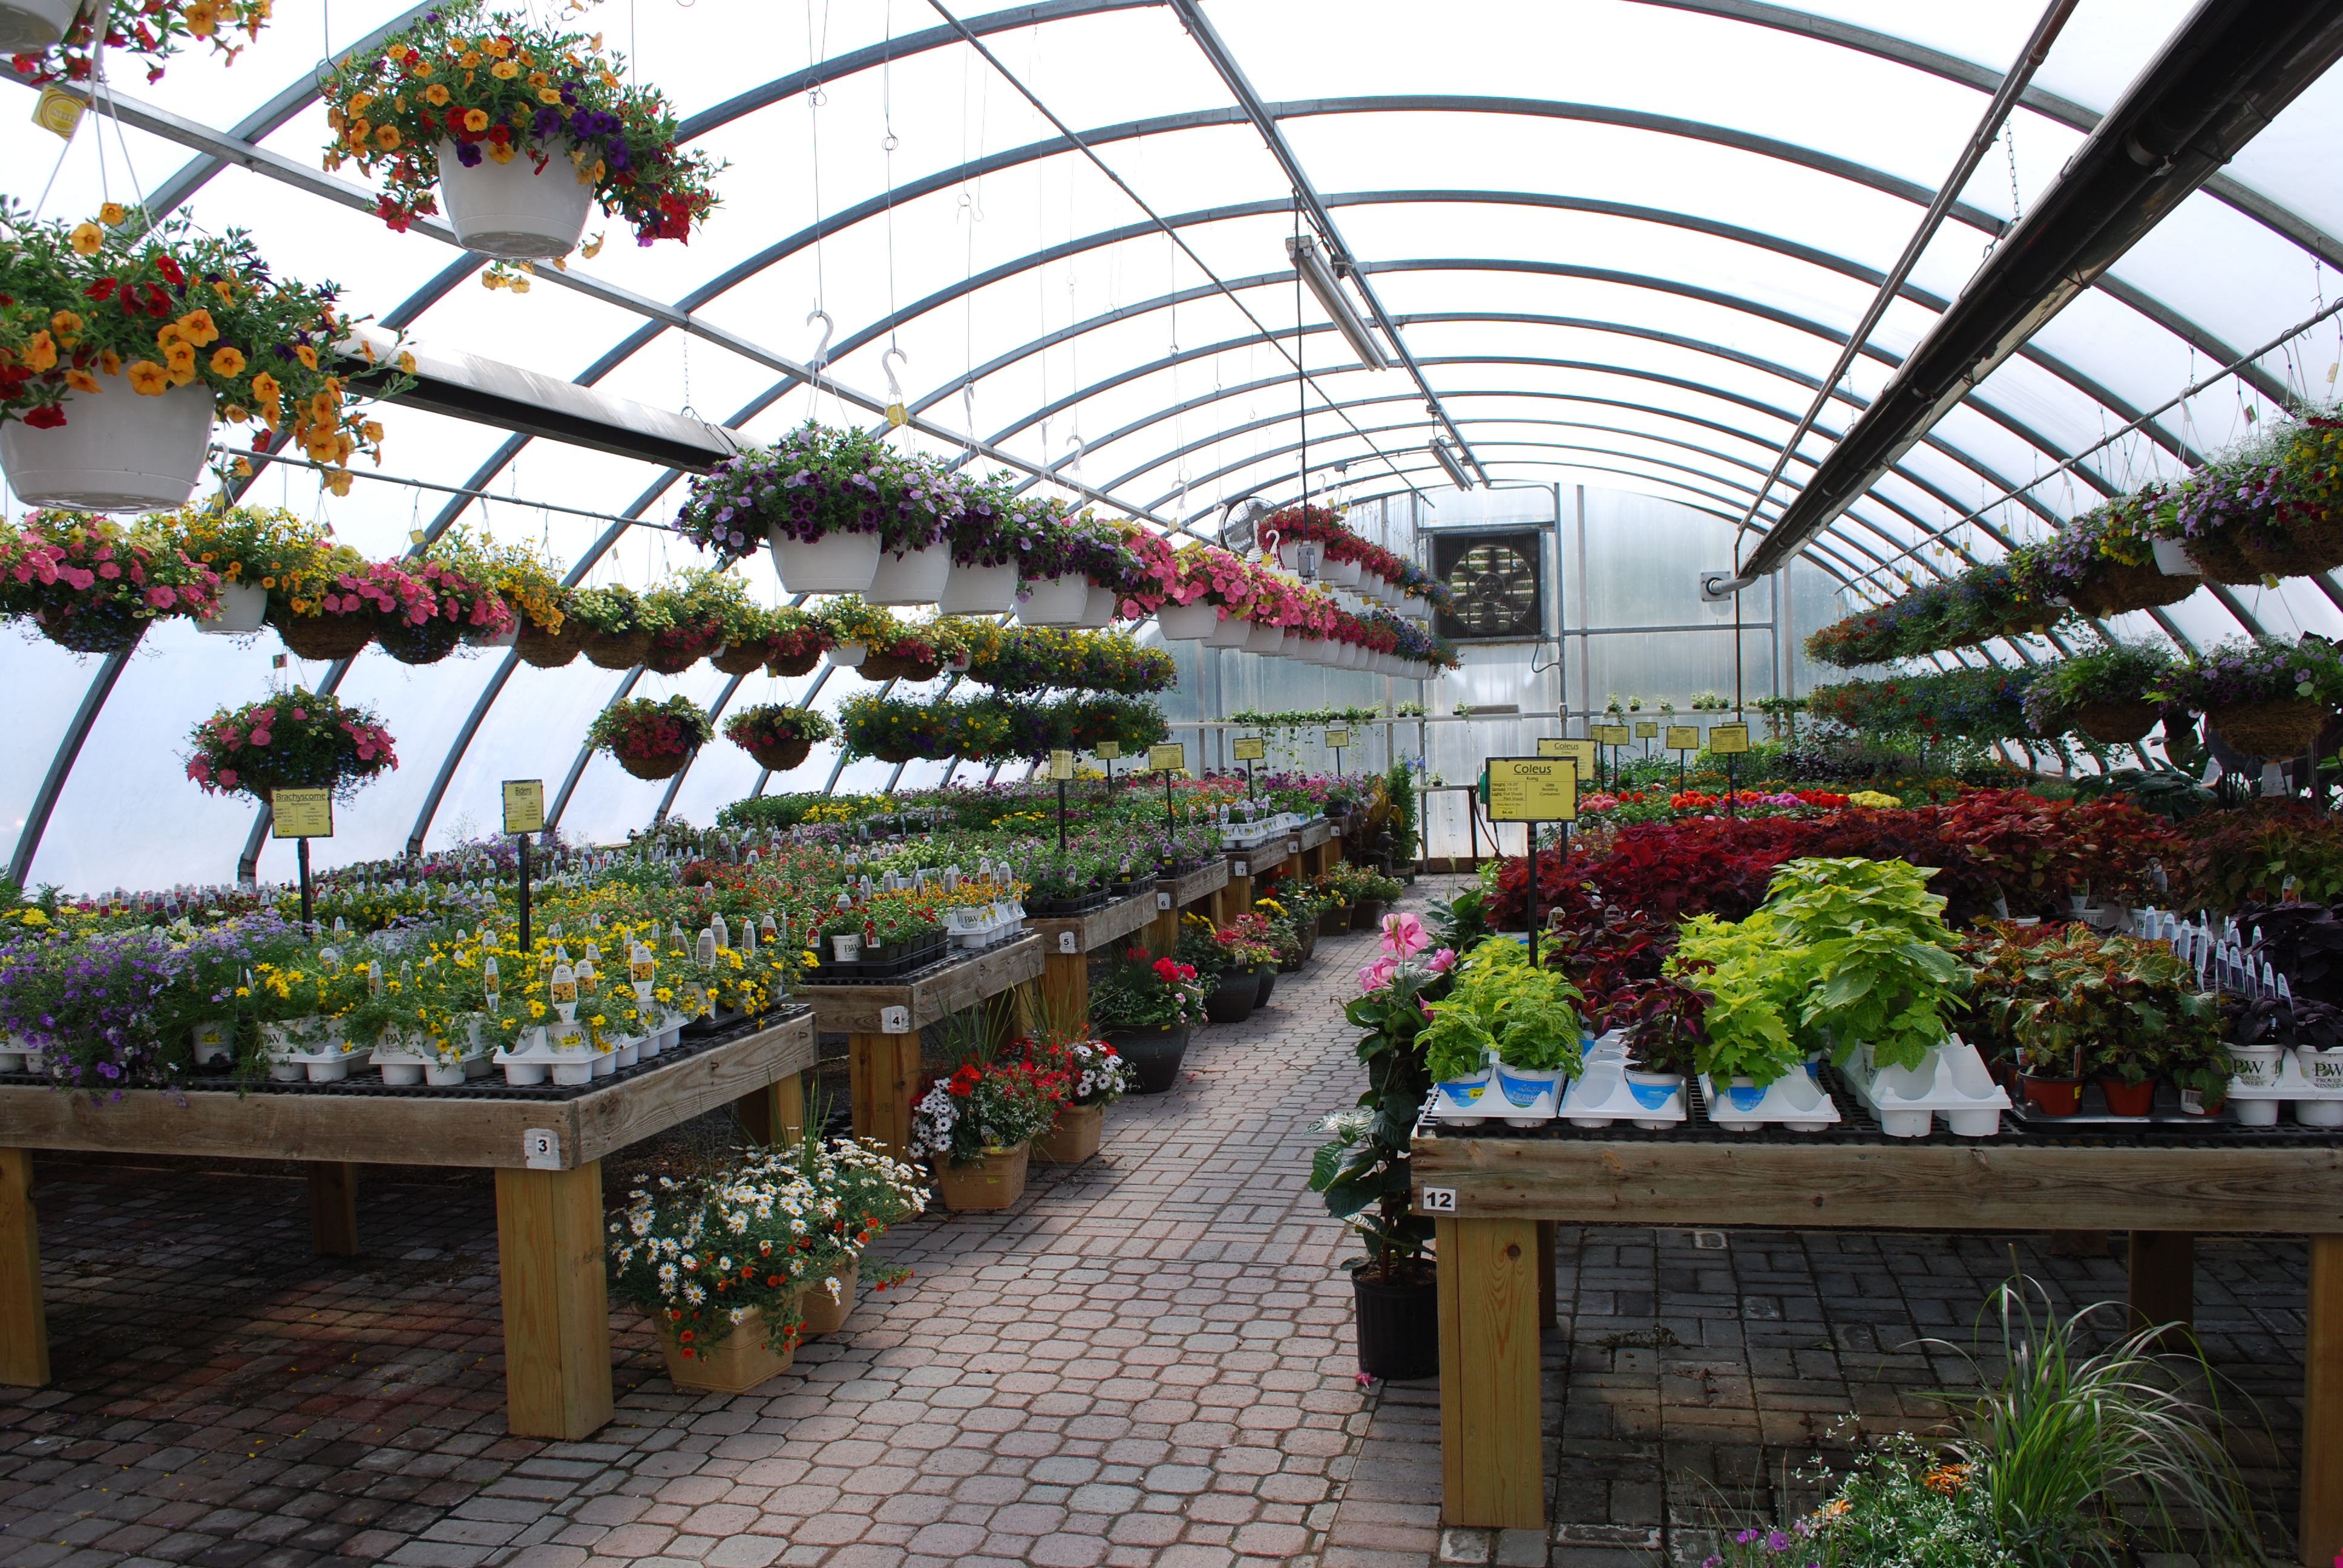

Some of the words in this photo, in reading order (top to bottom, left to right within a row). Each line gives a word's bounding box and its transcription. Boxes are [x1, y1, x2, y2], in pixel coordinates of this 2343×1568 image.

[1513, 763, 1552, 774] Coleus
[277, 792, 326, 802] Brachyscome
[893, 1016, 900, 1025] 4
[2233, 1060, 2265, 1074] PW
[2314, 1062, 2343, 1077] PW
[1513, 1091, 1538, 1100] Exclu
[538, 1139, 548, 1152] 3
[1427, 1192, 1452, 1207] 12
